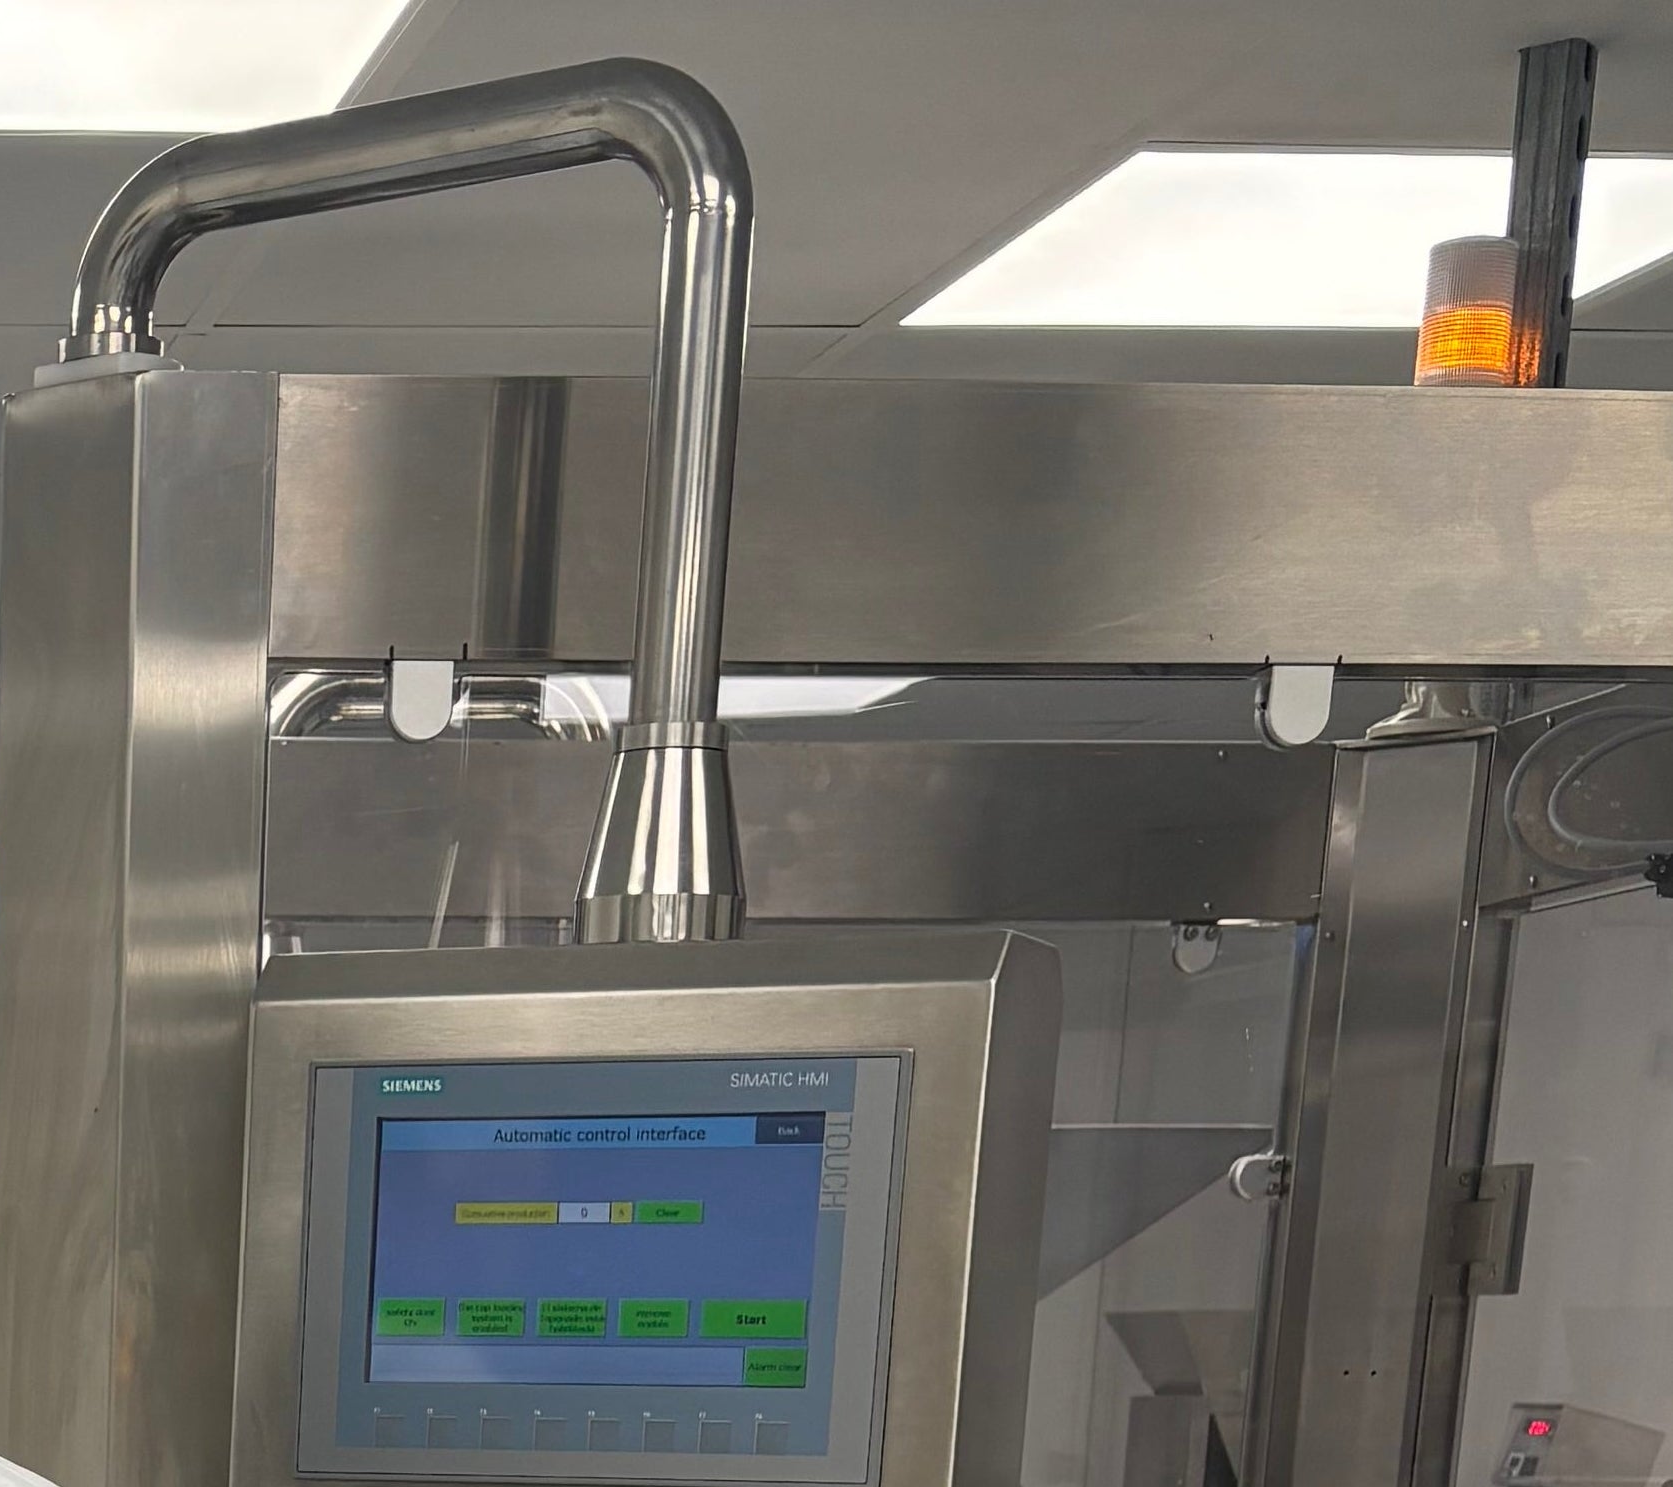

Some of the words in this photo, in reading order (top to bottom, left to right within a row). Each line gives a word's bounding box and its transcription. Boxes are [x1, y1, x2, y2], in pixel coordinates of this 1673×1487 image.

[382, 1079, 442, 1093] SIEMENS
[729, 1071, 793, 1088] SIMATIC
[798, 1071, 829, 1087] HMI
[493, 1128, 572, 1143] Automatic
[577, 1126, 631, 1142] control
[636, 1125, 707, 1141] interface
[820, 1114, 853, 1210] TOUCH
[735, 1313, 767, 1326] Start
